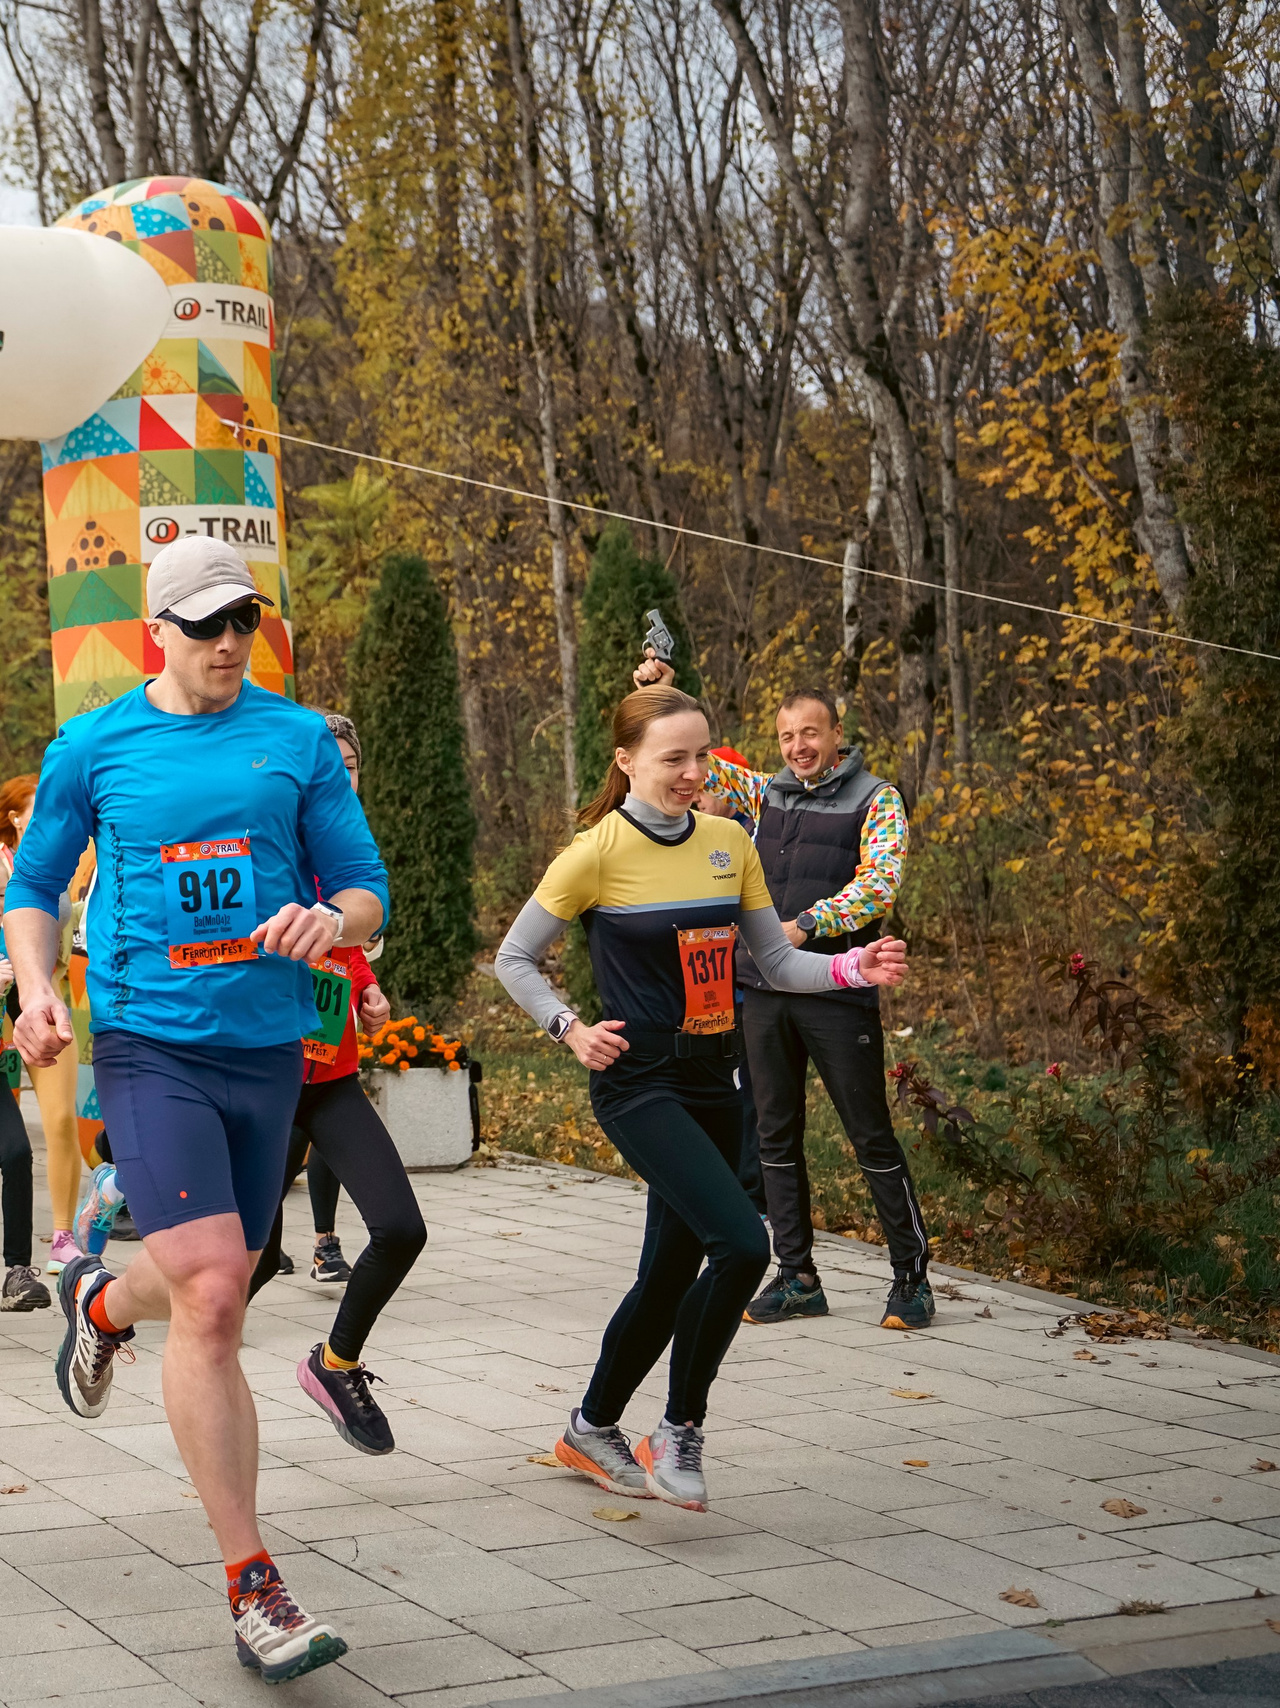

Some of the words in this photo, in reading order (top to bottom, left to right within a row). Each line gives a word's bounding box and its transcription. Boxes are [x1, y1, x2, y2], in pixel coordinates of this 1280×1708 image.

[178, 867, 243, 914] 912
[712, 872, 737, 881] TINKOFF
[686, 946, 728, 986] 1317
